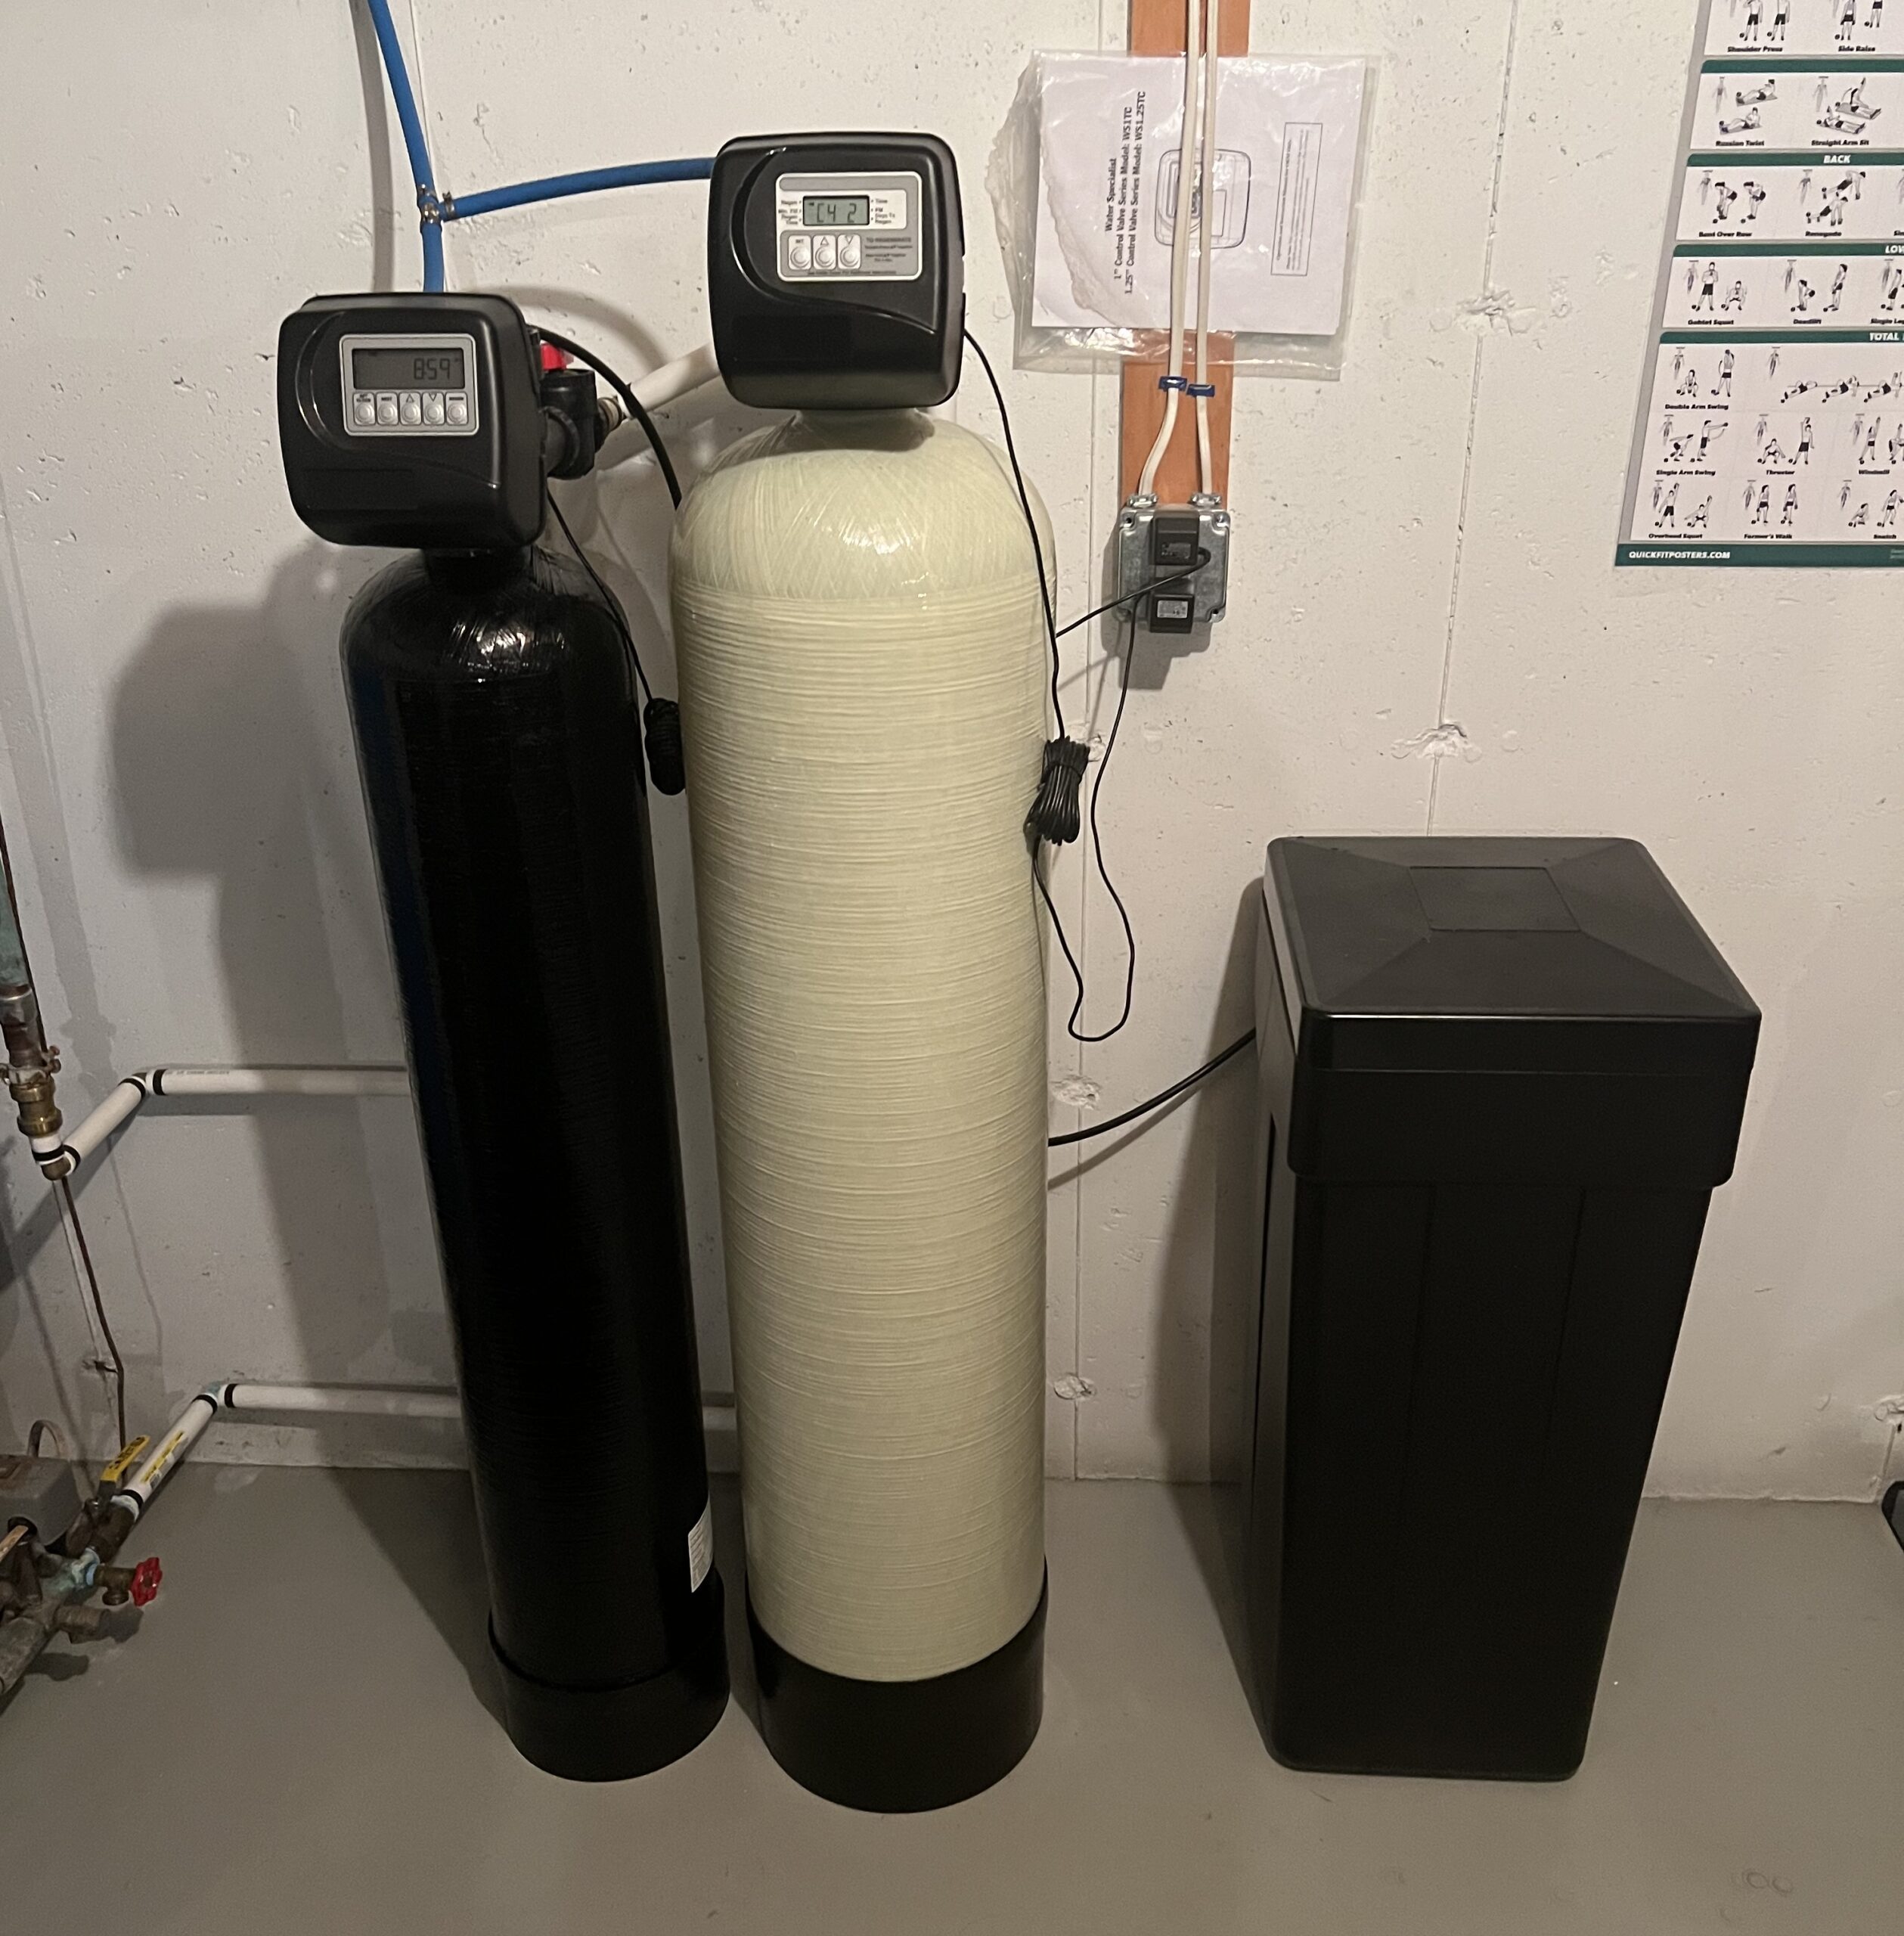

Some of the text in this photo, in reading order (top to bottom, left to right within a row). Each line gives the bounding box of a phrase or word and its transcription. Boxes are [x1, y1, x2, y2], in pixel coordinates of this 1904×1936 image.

[1122, 107, 1132, 141] WS1TC
[1120, 144, 1129, 174] Model:
[1132, 144, 1142, 175] Model:
[1823, 154, 1851, 164] BACK
[1118, 178, 1127, 206] Series
[1130, 178, 1140, 206] Series
[1105, 205, 1113, 231] Water
[1116, 208, 1125, 231] Valve
[1128, 209, 1137, 231] Valve
[1115, 234, 1124, 265] Control
[1127, 234, 1136, 266] Control
[1869, 332, 1899, 341] TOTAL
